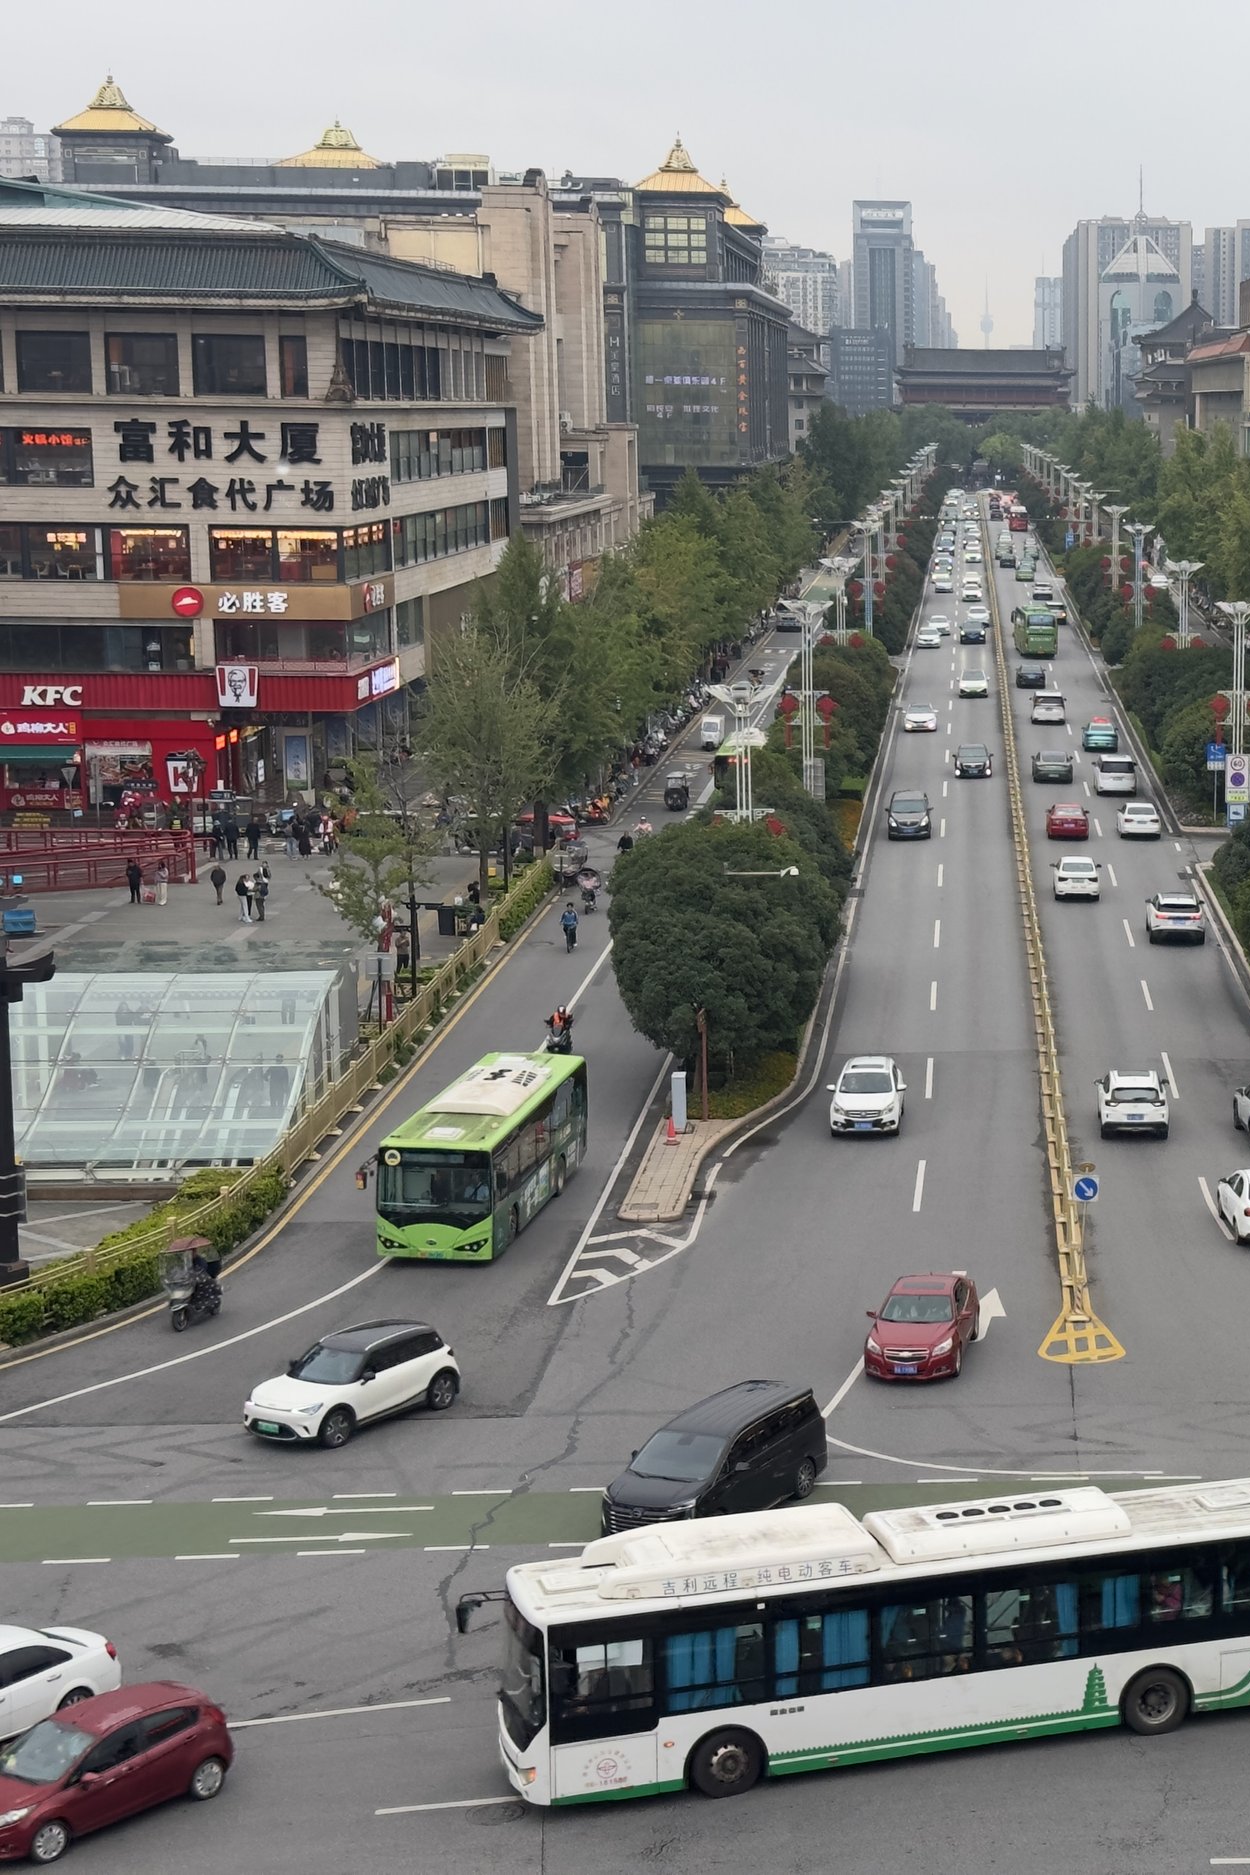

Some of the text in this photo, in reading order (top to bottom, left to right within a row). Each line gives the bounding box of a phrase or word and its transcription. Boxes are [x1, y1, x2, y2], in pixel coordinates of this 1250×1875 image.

[113, 418, 323, 464] 富和大厦
[107, 474, 335, 512] 众汇食代广场
[217, 591, 289, 613] 必胜客
[21, 685, 83, 706] KFC
[661, 1559, 853, 1596] 吉利远程 纯电动客车
